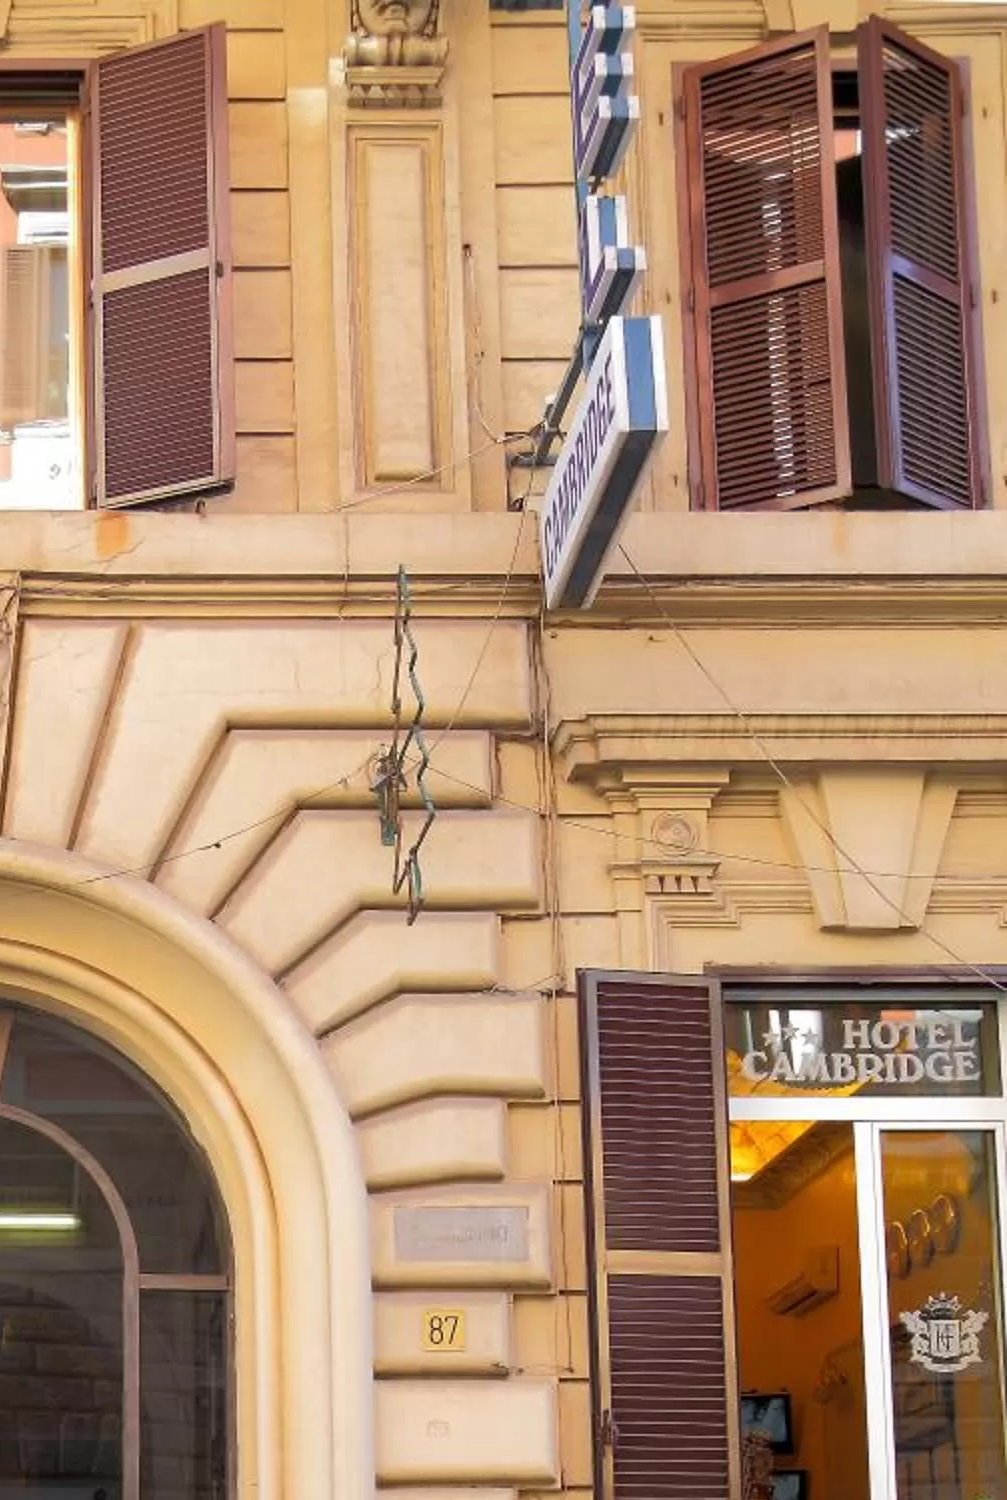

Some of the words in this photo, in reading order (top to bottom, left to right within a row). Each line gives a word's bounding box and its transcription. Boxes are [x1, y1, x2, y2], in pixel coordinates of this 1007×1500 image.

[544, 351, 615, 579] CAMBRIDGE
[843, 1019, 976, 1049] HOTEL
[742, 1050, 981, 1083] CAMBRIDGE
[429, 1315, 459, 1345] 87
